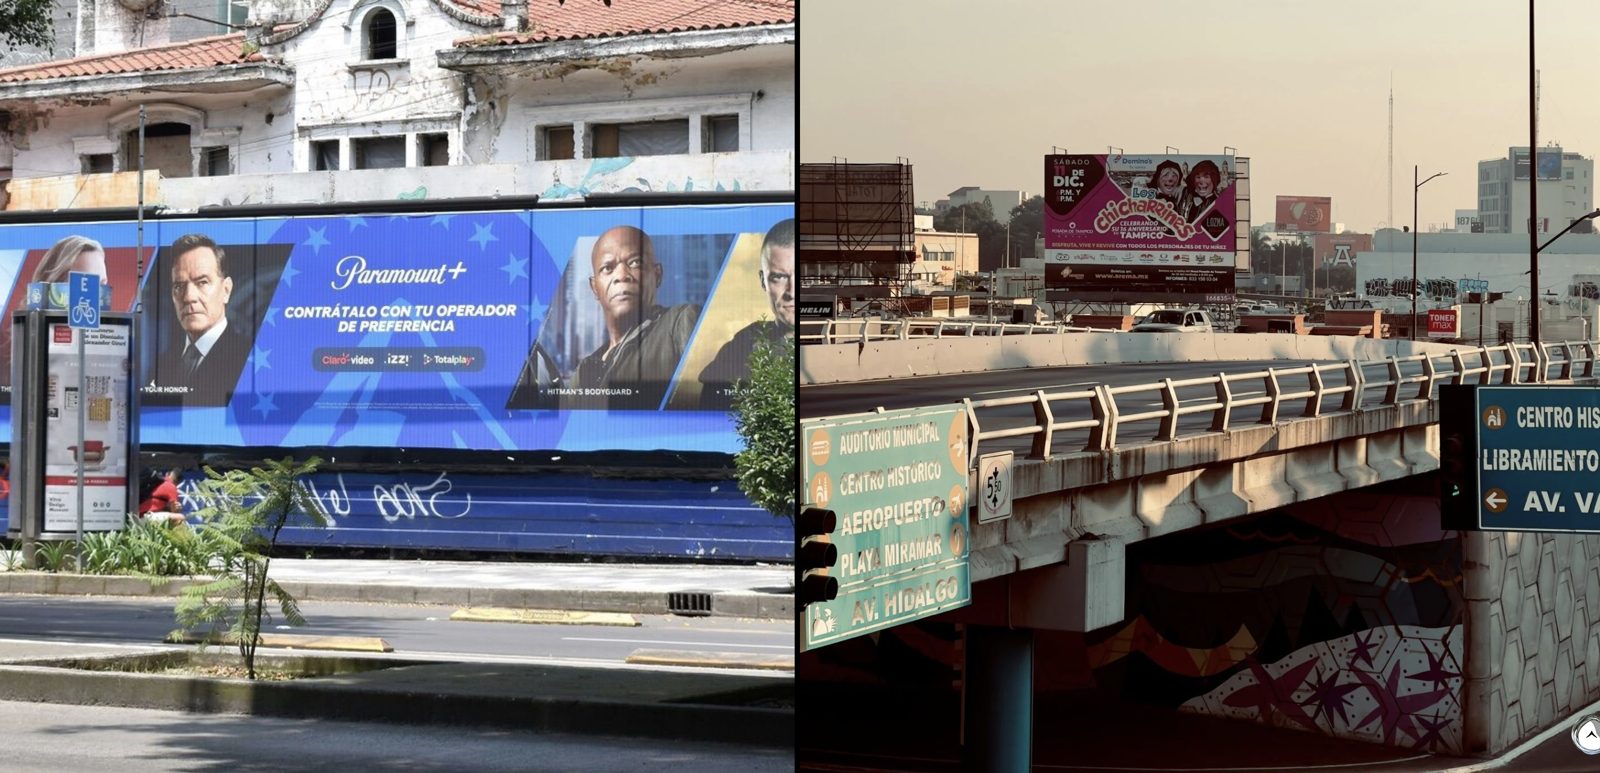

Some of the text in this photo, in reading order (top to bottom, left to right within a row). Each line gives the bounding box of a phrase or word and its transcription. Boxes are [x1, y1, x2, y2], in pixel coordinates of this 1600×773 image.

[1054, 158, 1090, 166] SÁBADO
[1072, 169, 1085, 177] DE
[1053, 176, 1085, 187] DIC.
[1132, 187, 1156, 199] Los
[1120, 231, 1164, 240] TAMPICO
[331, 255, 468, 290] Paramount+
[81, 277, 89, 292] E
[284, 303, 517, 318] CONTRÁTALO CON TU OPERADOR
[800, 306, 832, 314] HELIN
[1429, 314, 1455, 322] TONER
[338, 320, 455, 333] DE PREFERENCIA
[434, 354, 473, 366] Totalplay
[547, 388, 632, 396] HITMAN'S BODYGUARD
[1516, 406, 1573, 429] CENTRO
[839, 421, 940, 456] AUDITORIO MUNICIPAL
[1482, 448, 1599, 472] LIBRAMIENTO
[840, 468, 885, 496] CENTRO
[1523, 490, 1566, 513] AV.
[841, 496, 945, 537] AEROPUERTO
[841, 533, 942, 578] PLAYA MIRAMAR
[852, 576, 959, 626] AV. HIDALGO
